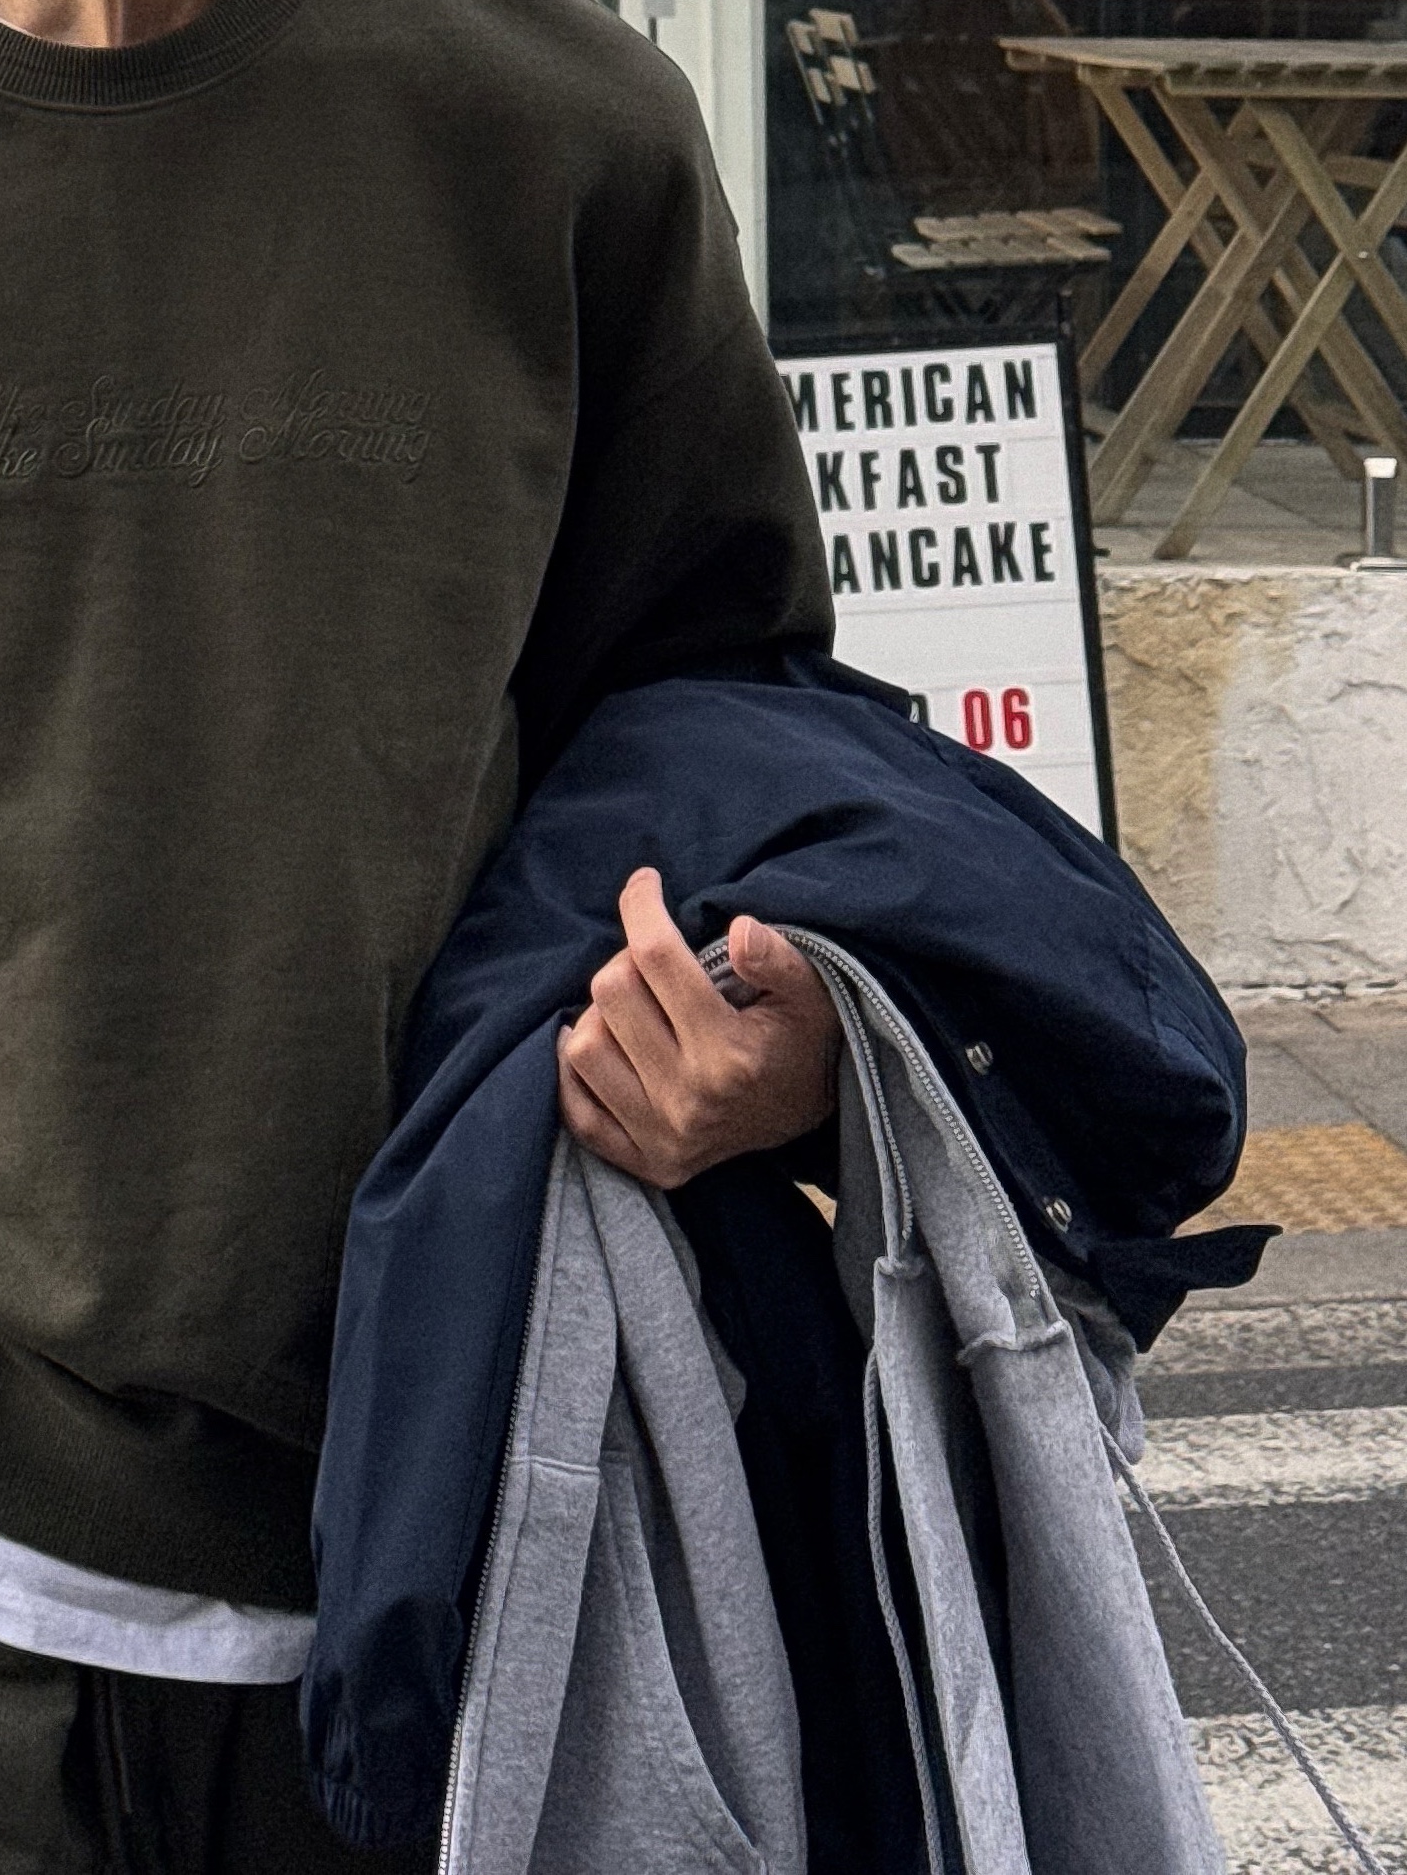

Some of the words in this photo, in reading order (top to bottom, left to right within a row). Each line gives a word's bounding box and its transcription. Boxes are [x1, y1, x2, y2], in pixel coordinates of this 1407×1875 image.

[780, 359, 1038, 433] MERICAN
[53, 416, 225, 487] Sunday
[815, 443, 1002, 513] KFAST
[833, 521, 1056, 595] ANCAKE
[963, 687, 1033, 752] 06
